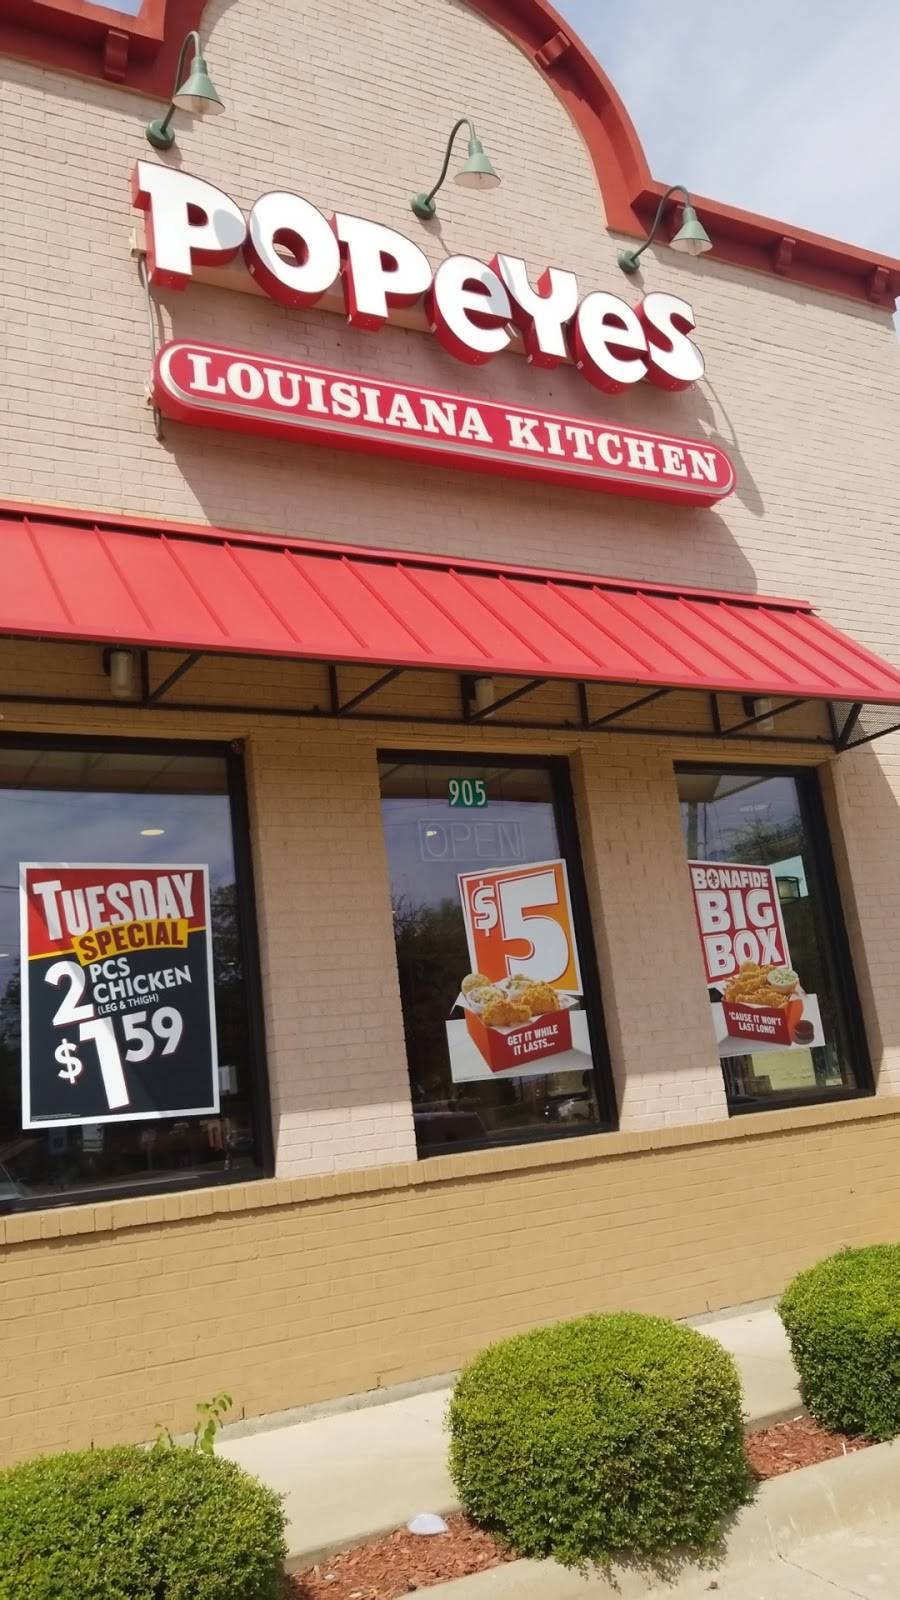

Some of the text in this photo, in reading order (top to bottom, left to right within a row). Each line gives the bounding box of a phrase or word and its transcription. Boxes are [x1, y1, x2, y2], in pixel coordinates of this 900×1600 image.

[186, 351, 719, 483] LOUISIANA KITCHEN
[448, 779, 486, 806] 905
[425, 822, 521, 857] OPEN
[690, 867, 769, 890] BONAFIDE
[32, 872, 196, 941] TUESDAY
[695, 888, 776, 934] BIG
[78, 921, 184, 961] SPECIAL
[703, 927, 783, 978] BOX
[44, 957, 131, 1026] 2 PCS
[93, 964, 192, 1004] CHICKEN
[97, 993, 160, 1016] (LEG & THIGH)
[752, 1014, 760, 1024] IT
[760, 1015, 782, 1027] WON'T
[507, 1024, 559, 1046] GET IT WHILE
[738, 1022, 755, 1032] LAST
[513, 1044, 522, 1056] IT
